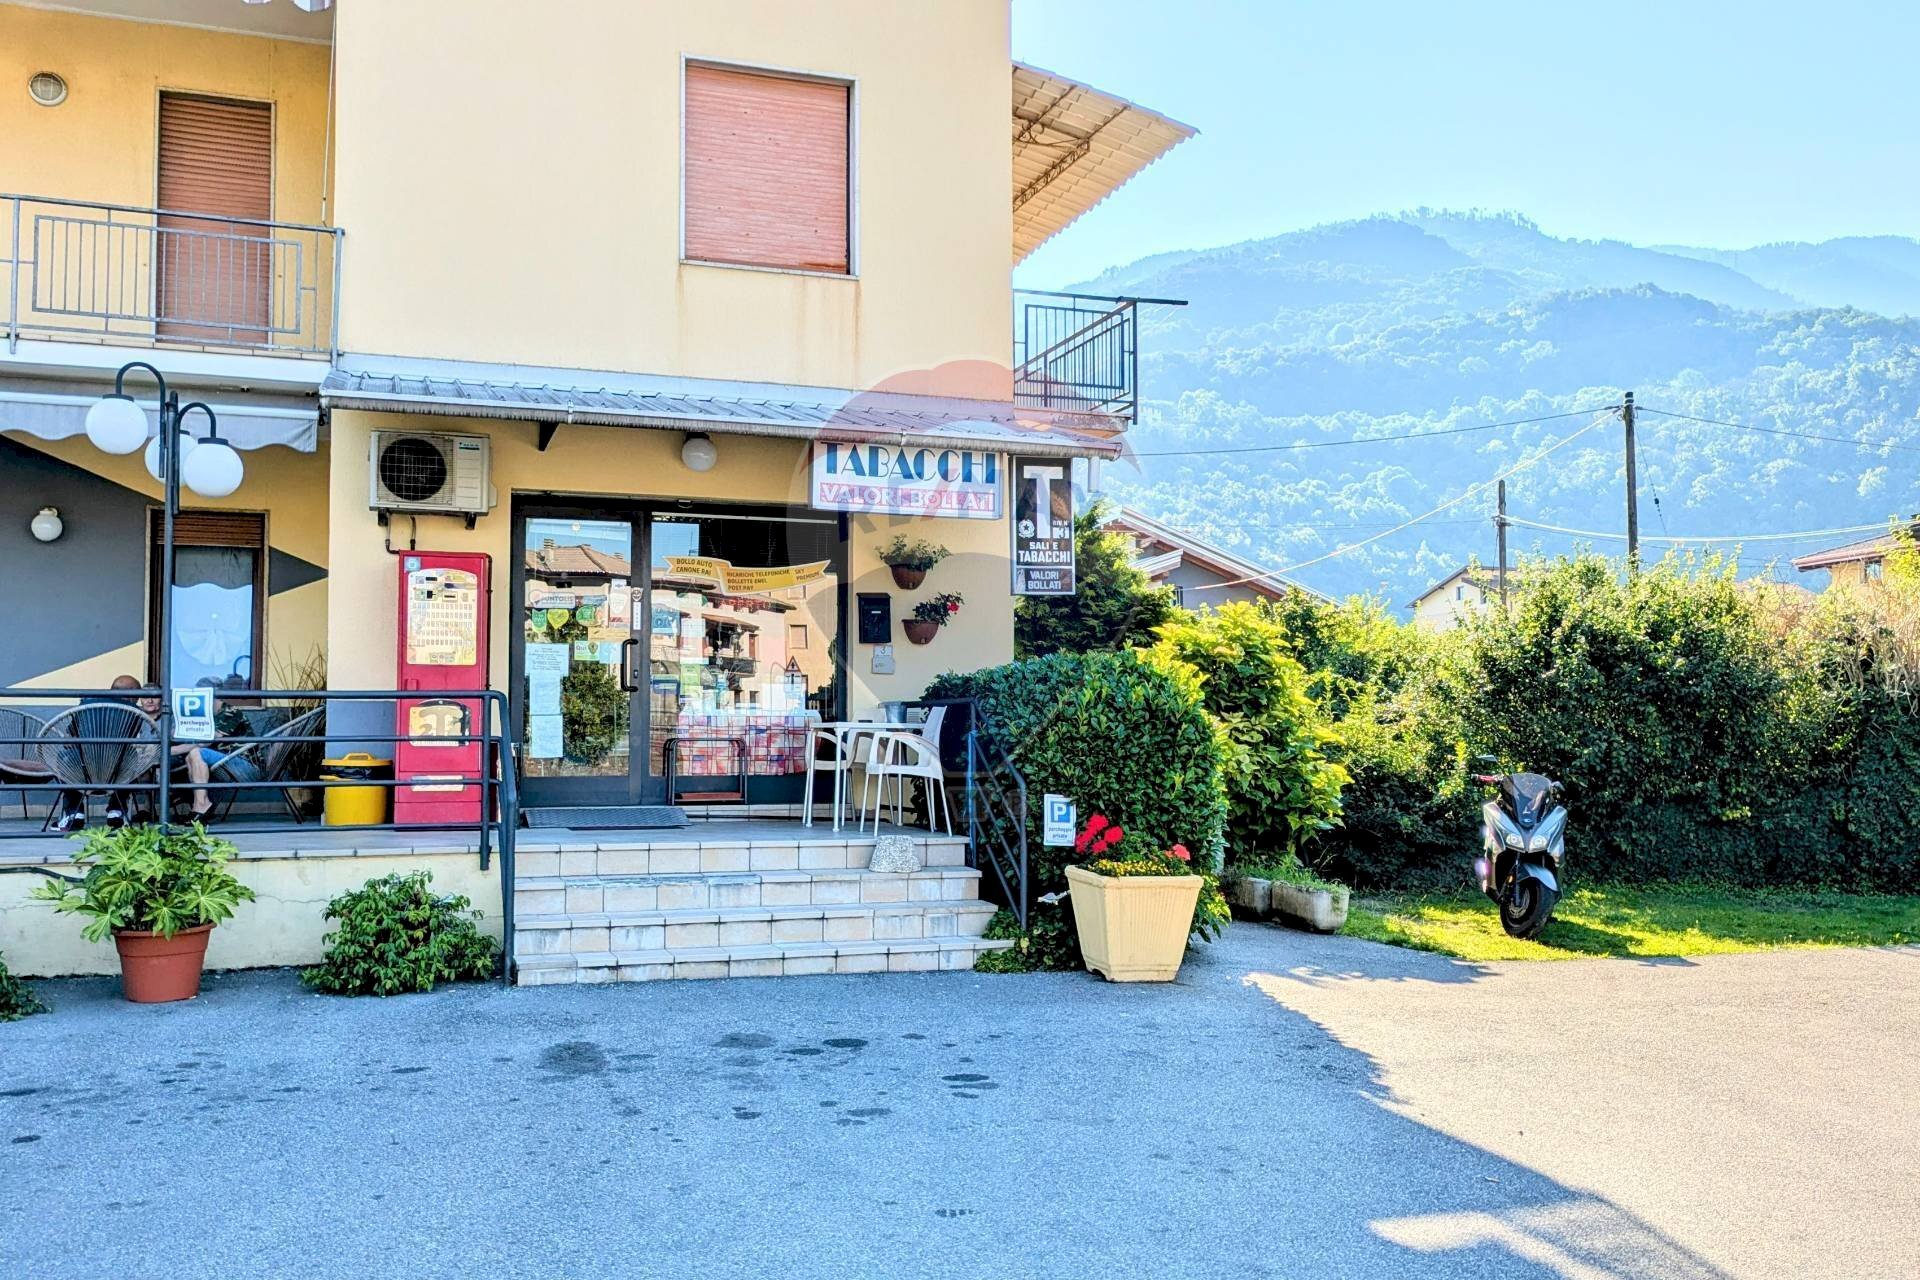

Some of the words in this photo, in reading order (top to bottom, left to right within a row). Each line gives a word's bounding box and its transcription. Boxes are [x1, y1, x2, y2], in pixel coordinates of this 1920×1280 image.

[820, 441, 996, 484] TABACCHI
[821, 484, 900, 506] VALORI
[910, 488, 995, 511] BOLLATI
[1023, 465, 1063, 538] T
[1029, 541, 1050, 550] SALI
[1052, 541, 1059, 550] E
[1018, 550, 1071, 563] TABACCHI
[676, 566, 700, 574] CANONE
[696, 559, 713, 568] AUTO
[1029, 570, 1060, 580] VALORI
[1027, 580, 1062, 590] BOLLATI
[183, 696, 201, 716] P
[1053, 803, 1067, 822] P
